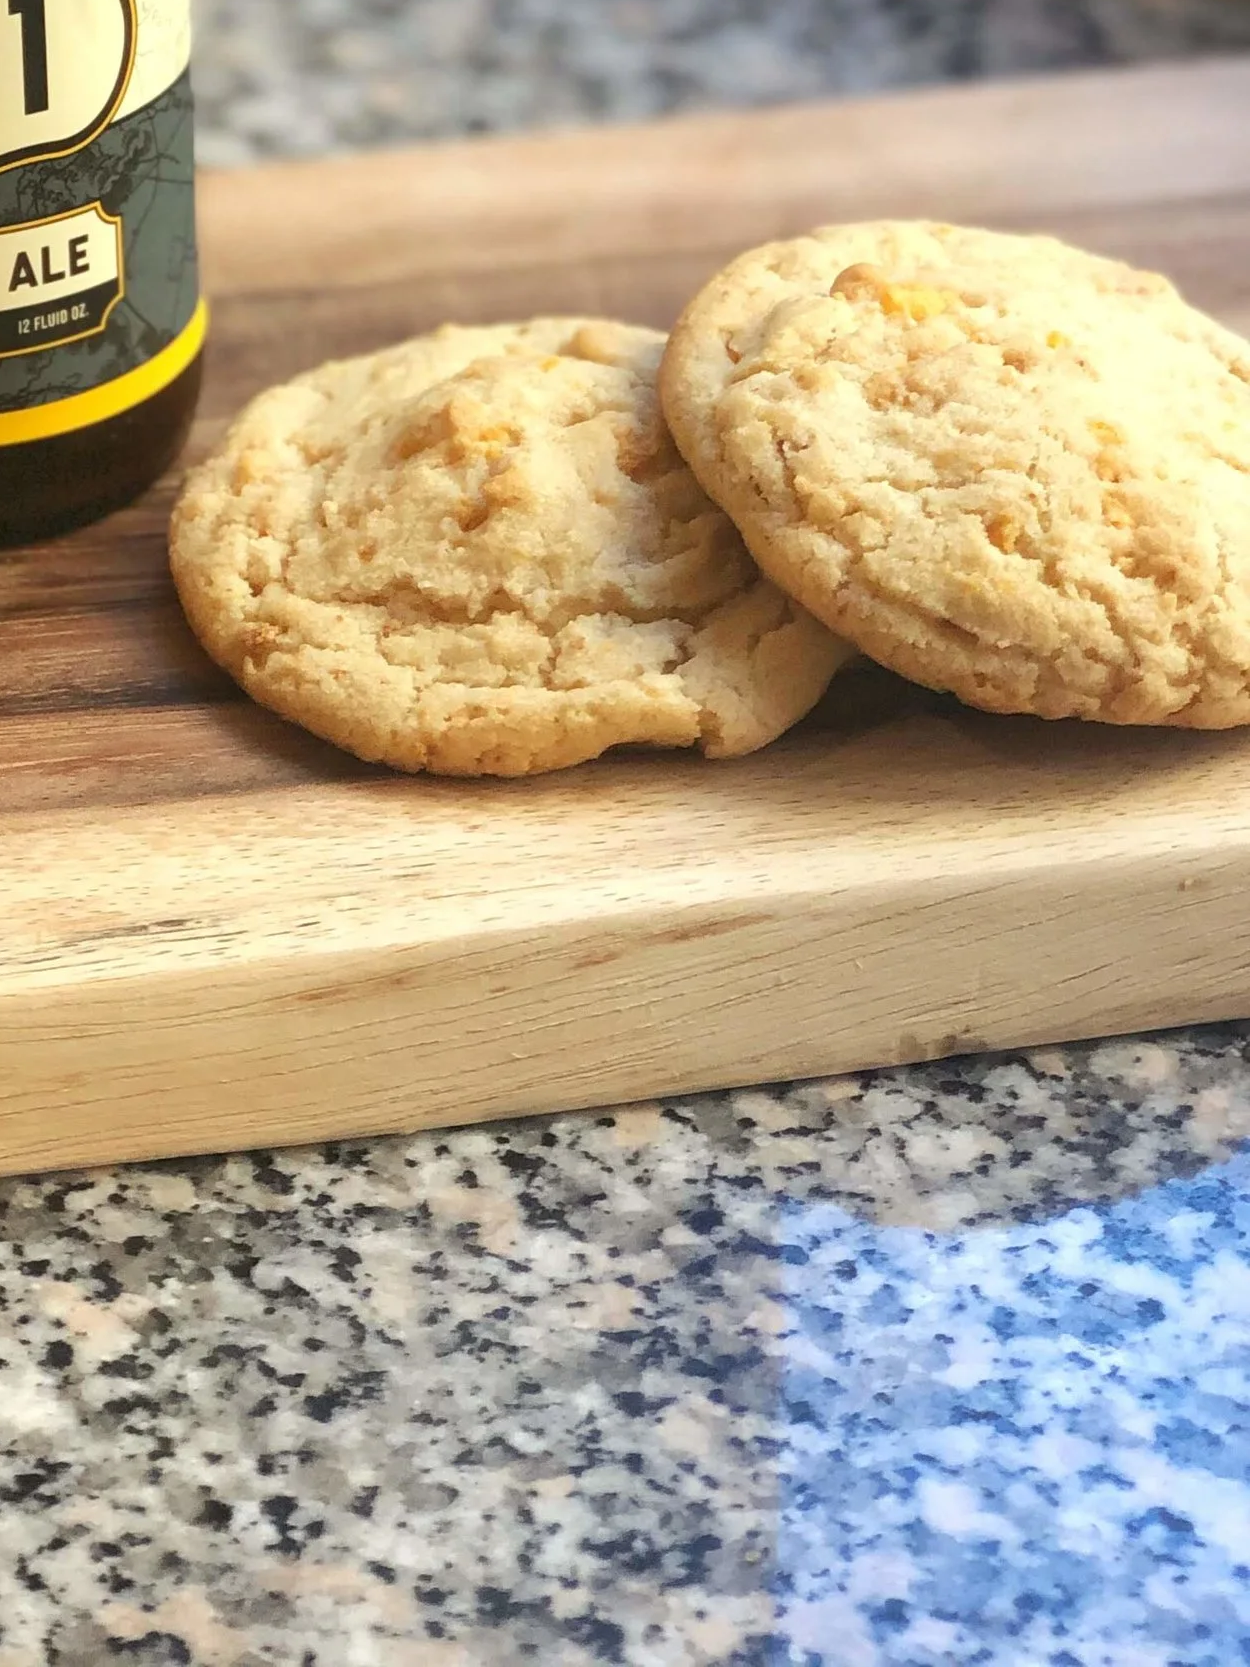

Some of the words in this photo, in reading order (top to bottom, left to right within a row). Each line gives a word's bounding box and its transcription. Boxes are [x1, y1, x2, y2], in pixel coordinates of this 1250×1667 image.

[8, 234, 91, 292] ALE
[18, 319, 30, 334] 12
[33, 309, 68, 331] FLUID
[71, 302, 90, 321] OZ.
